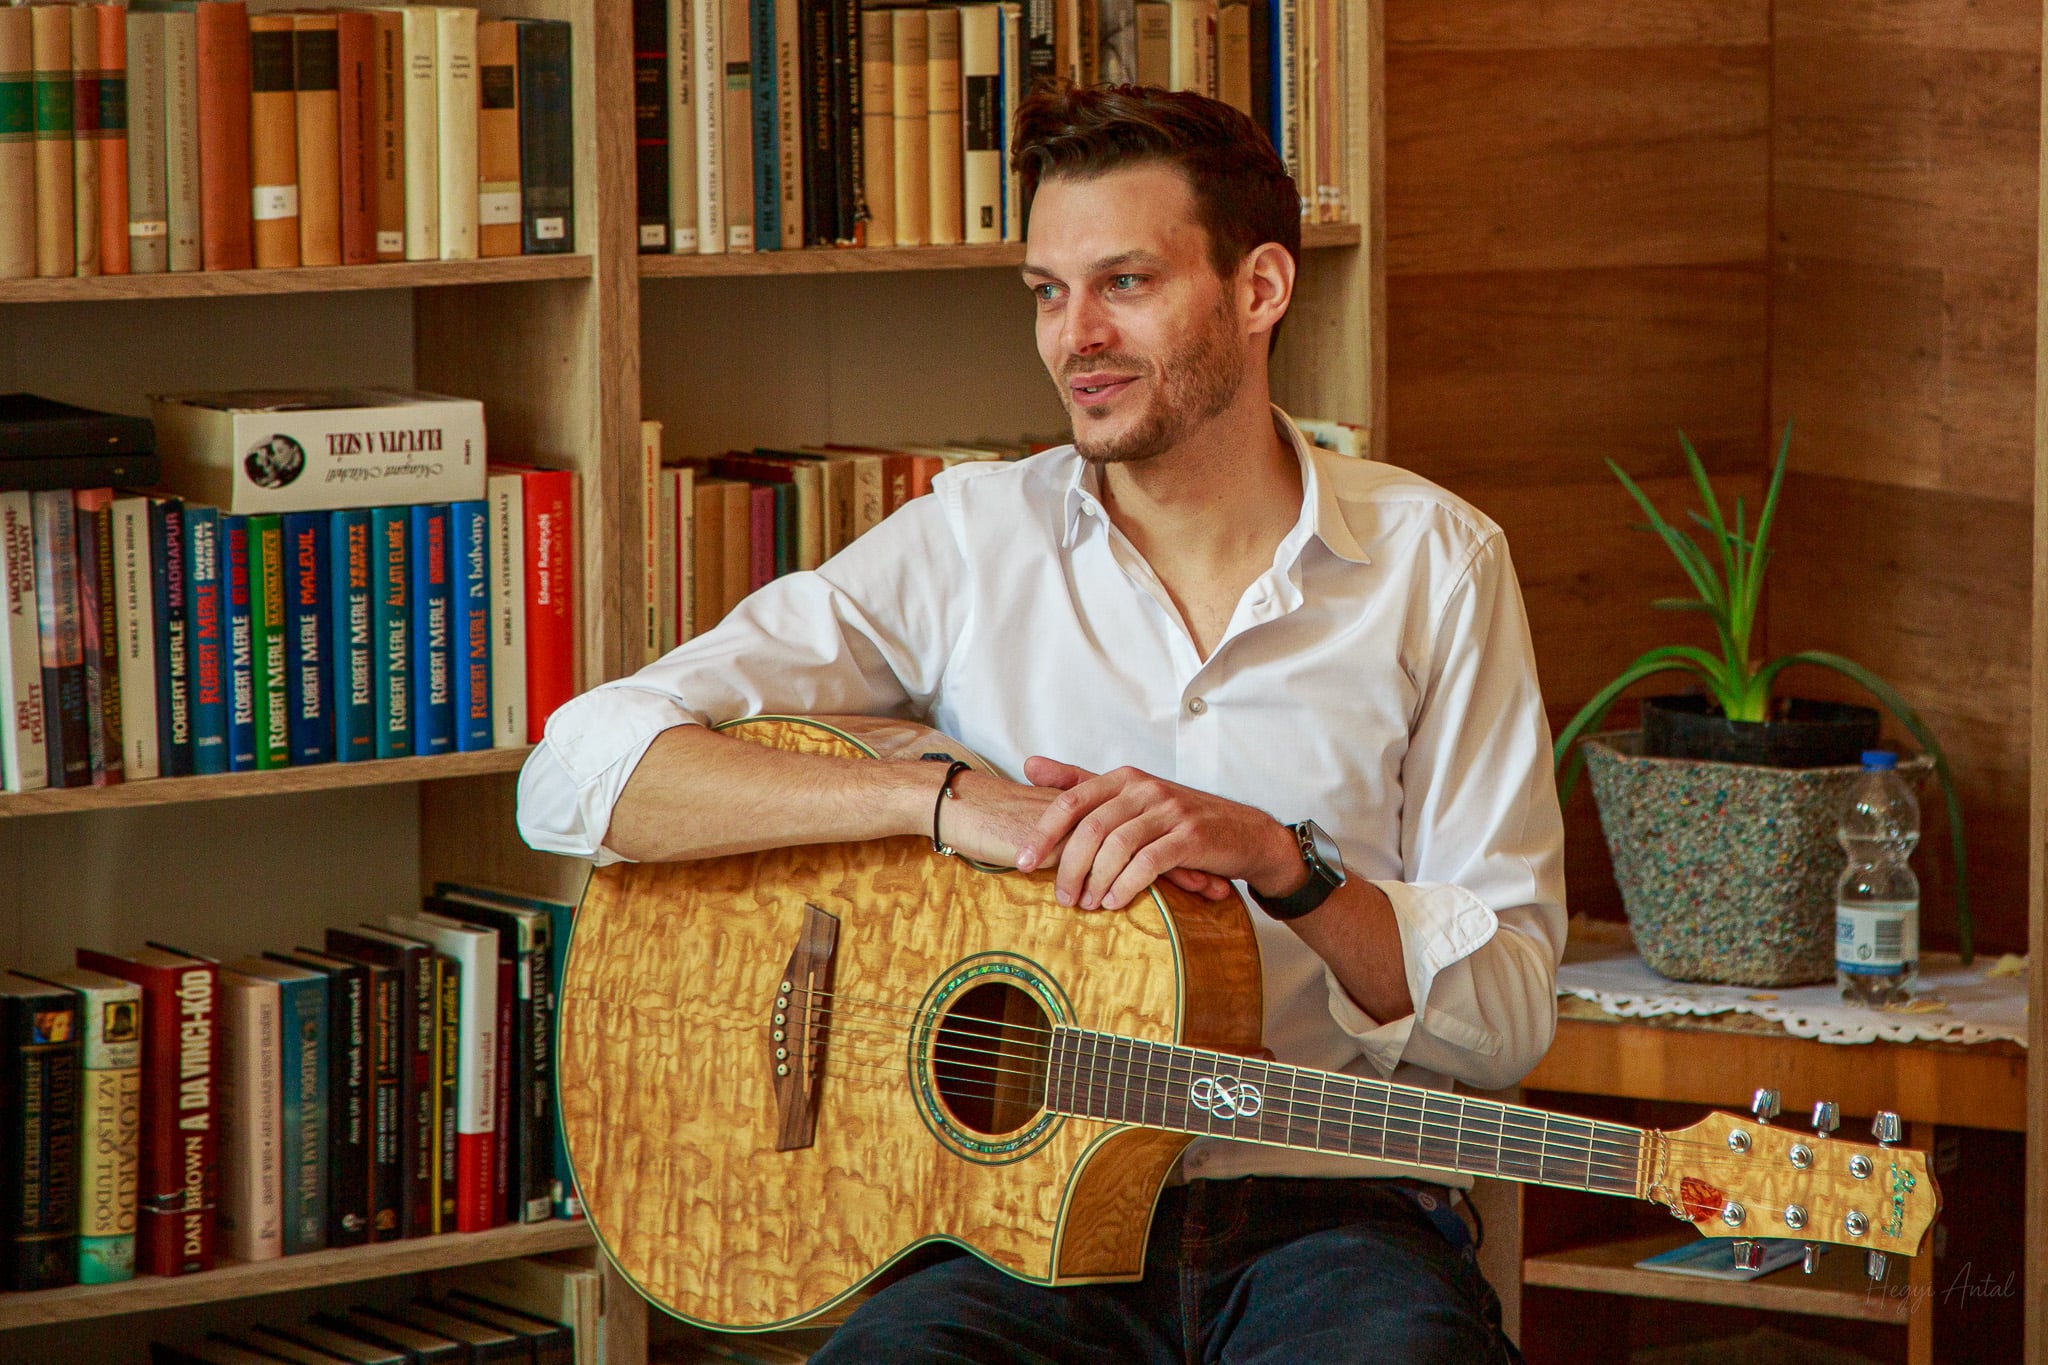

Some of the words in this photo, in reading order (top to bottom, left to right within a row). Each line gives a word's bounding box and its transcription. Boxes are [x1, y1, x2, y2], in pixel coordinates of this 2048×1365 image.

[760, 91, 770, 101] A
[325, 433, 361, 462] SZÉL
[365, 432, 373, 454] A
[378, 429, 442, 459] ELFÚJTA
[325, 466, 382, 483] Mitchell
[166, 512, 184, 607] MADRAPUR
[299, 528, 317, 605] MALEVIL
[385, 520, 405, 563] ELMÉK
[468, 513, 486, 580] bálvány
[12, 604, 23, 615] A
[386, 564, 405, 607] ÁLLATI
[502, 589, 511, 598] A
[538, 569, 550, 605] Edvard
[195, 584, 218, 639] MERLE
[350, 594, 368, 645] MERLE
[429, 597, 446, 648] MERLE
[469, 608, 486, 658] MERLE
[502, 606, 512, 646] MERLE
[170, 620, 186, 677] MERLE
[232, 615, 251, 666] MERLE
[266, 633, 284, 687] MERLE
[300, 614, 318, 662] MERLE
[389, 619, 406, 671] MERLE
[197, 642, 219, 705] ROBERT
[234, 670, 253, 724] ROBERT
[302, 666, 320, 718] ROBERT
[352, 649, 370, 705] ROBERT
[430, 650, 447, 705] ROBERT
[470, 663, 487, 719] ROBERT
[17, 700, 30, 731] KEN
[28, 683, 42, 744] FOLLETT
[172, 678, 189, 744] ROBERT
[268, 691, 287, 748] ROBERT
[389, 675, 407, 732] ROBERT
[175, 970, 212, 1078] VINCI-KÓD
[99, 1074, 114, 1100] AZ
[180, 1079, 210, 1109] DA
[442, 1079, 456, 1088] A
[480, 1068, 492, 1116] Kennedy
[180, 1112, 210, 1130] A
[117, 1072, 139, 1233] LEONARDO
[185, 1135, 204, 1209] BROWN
[95, 1160, 114, 1232] TUDÓS
[184, 1214, 202, 1256] DAN
